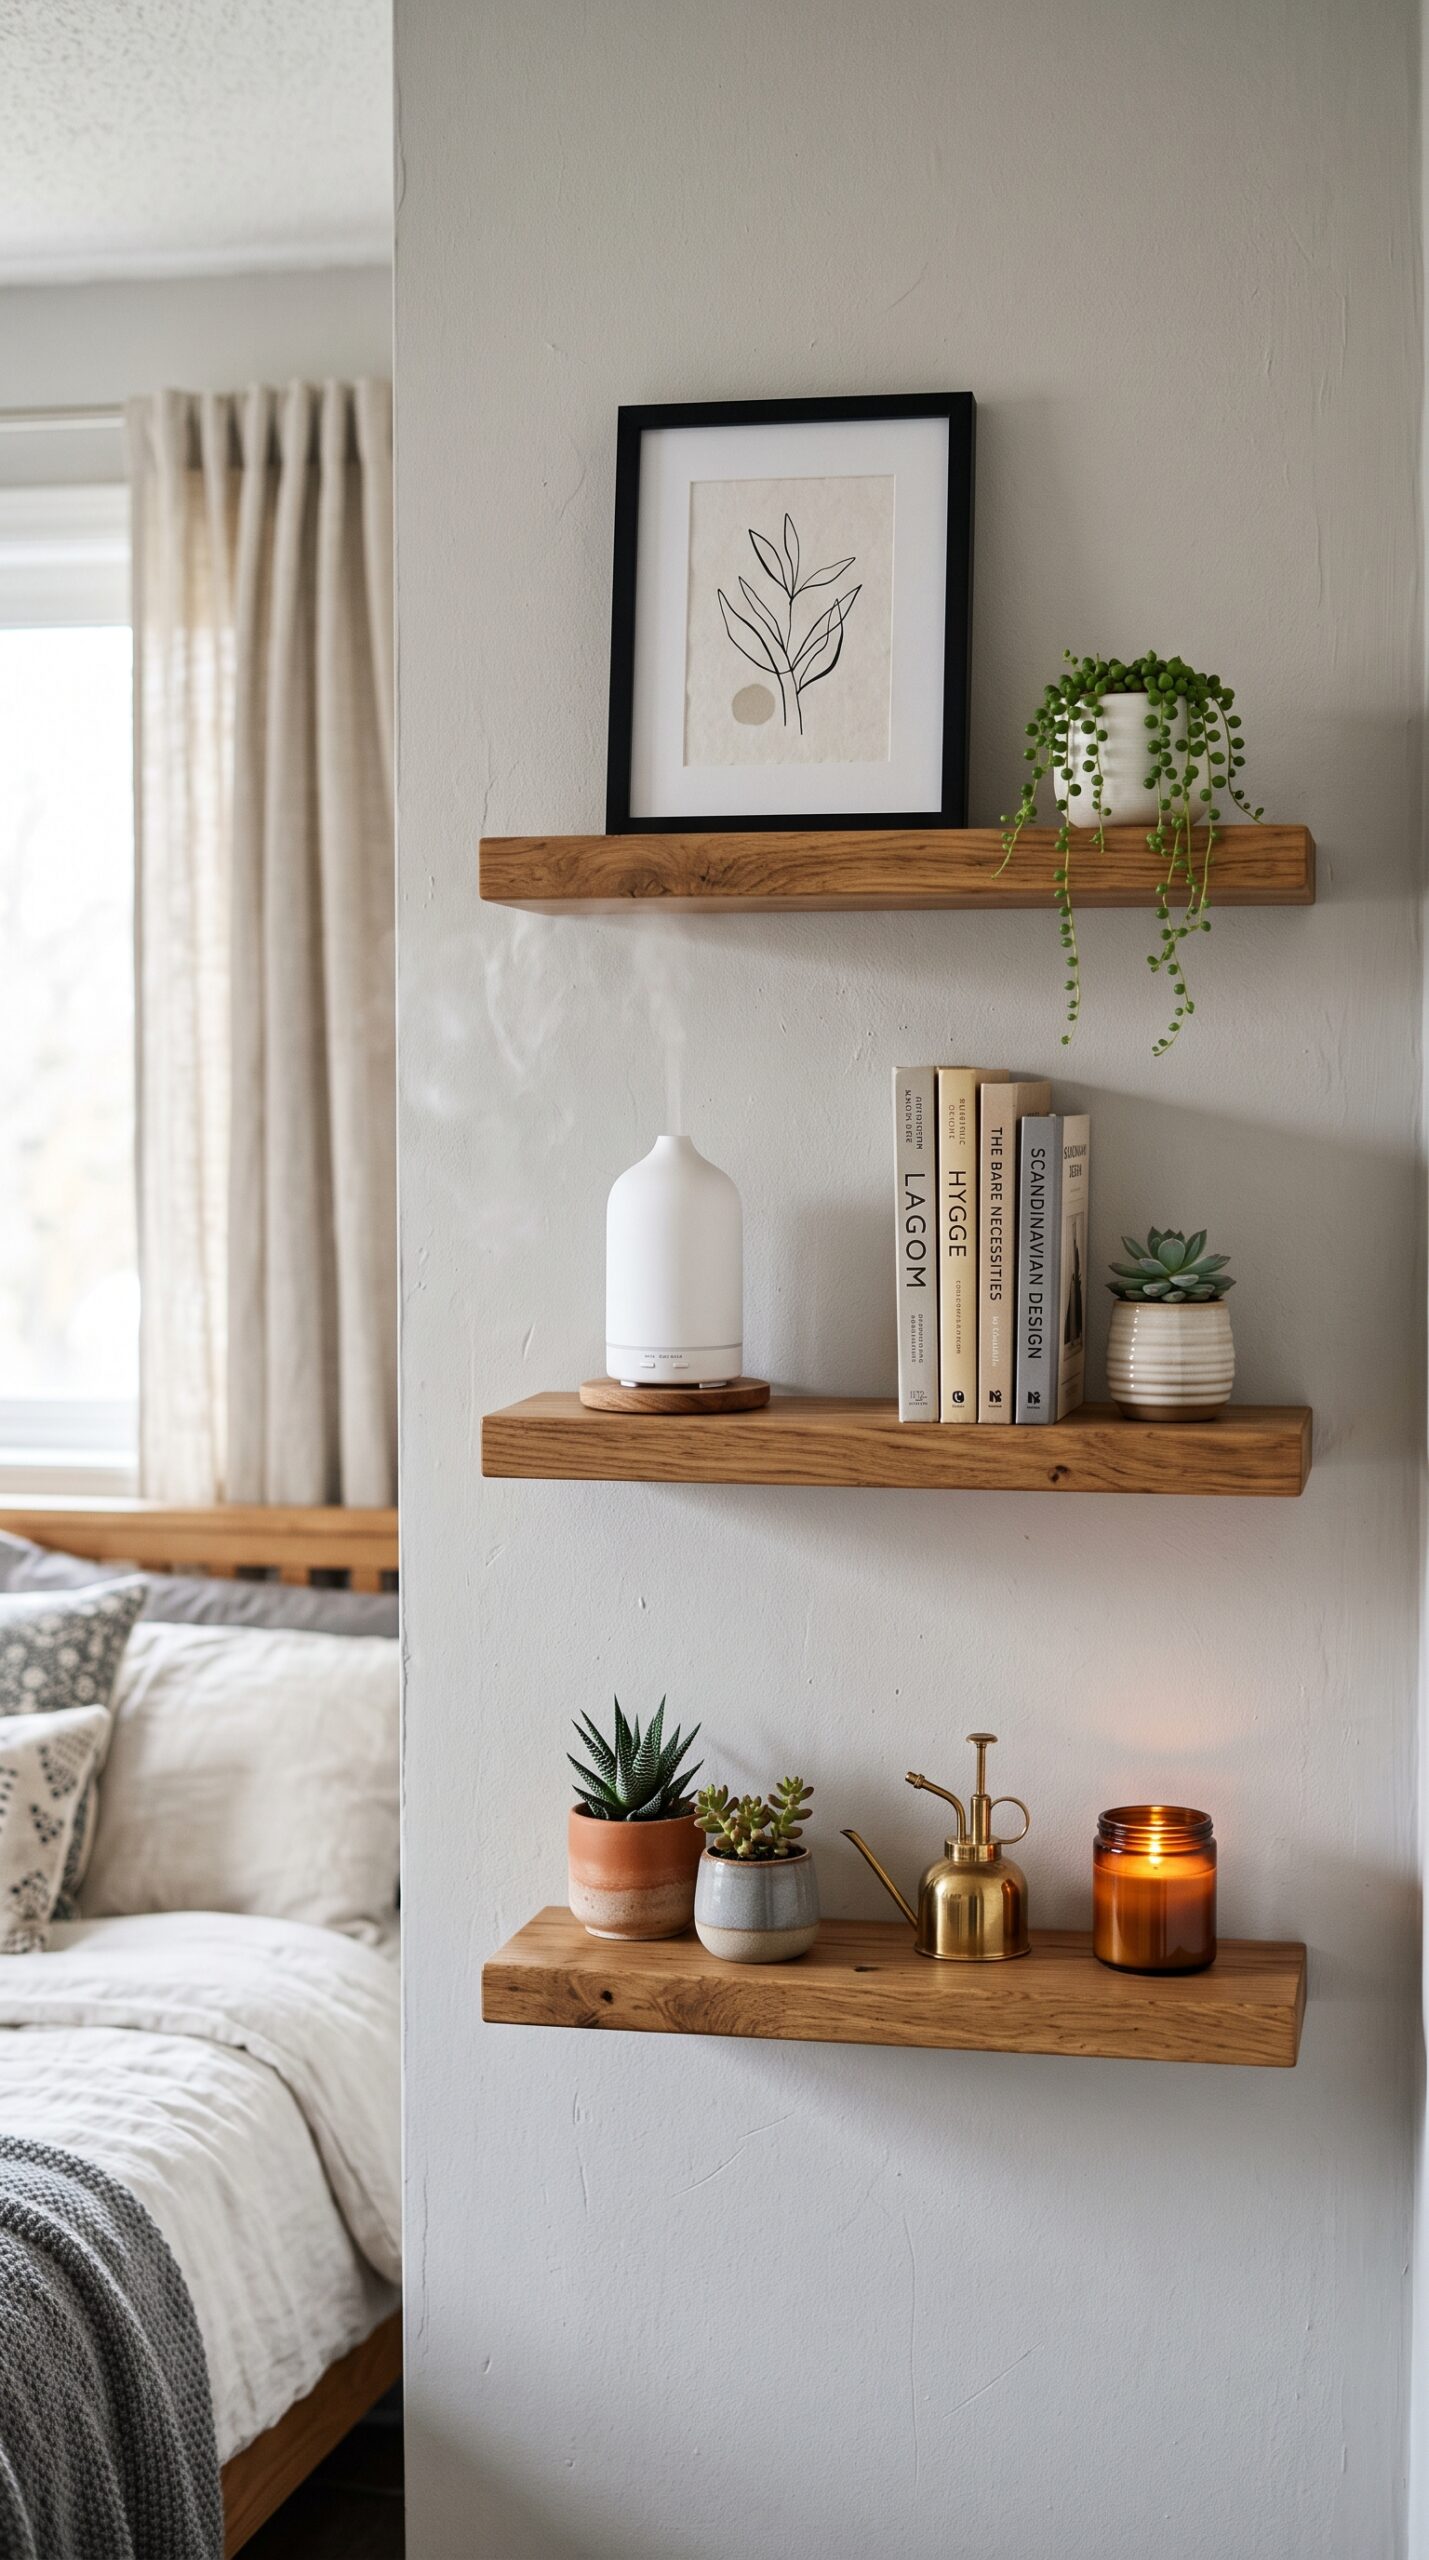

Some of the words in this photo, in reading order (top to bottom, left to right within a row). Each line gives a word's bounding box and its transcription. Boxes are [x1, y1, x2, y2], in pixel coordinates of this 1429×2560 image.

[990, 1127, 1003, 1156] THE
[990, 1162, 1003, 1201] BARE
[905, 1172, 927, 1288] LAGOM
[948, 1170, 967, 1258] HYGGE
[989, 1206, 1003, 1302] NECESSITIES
[1029, 1148, 1046, 1286] SCANDINAVIAN
[1027, 1292, 1043, 1360] DESIGN
